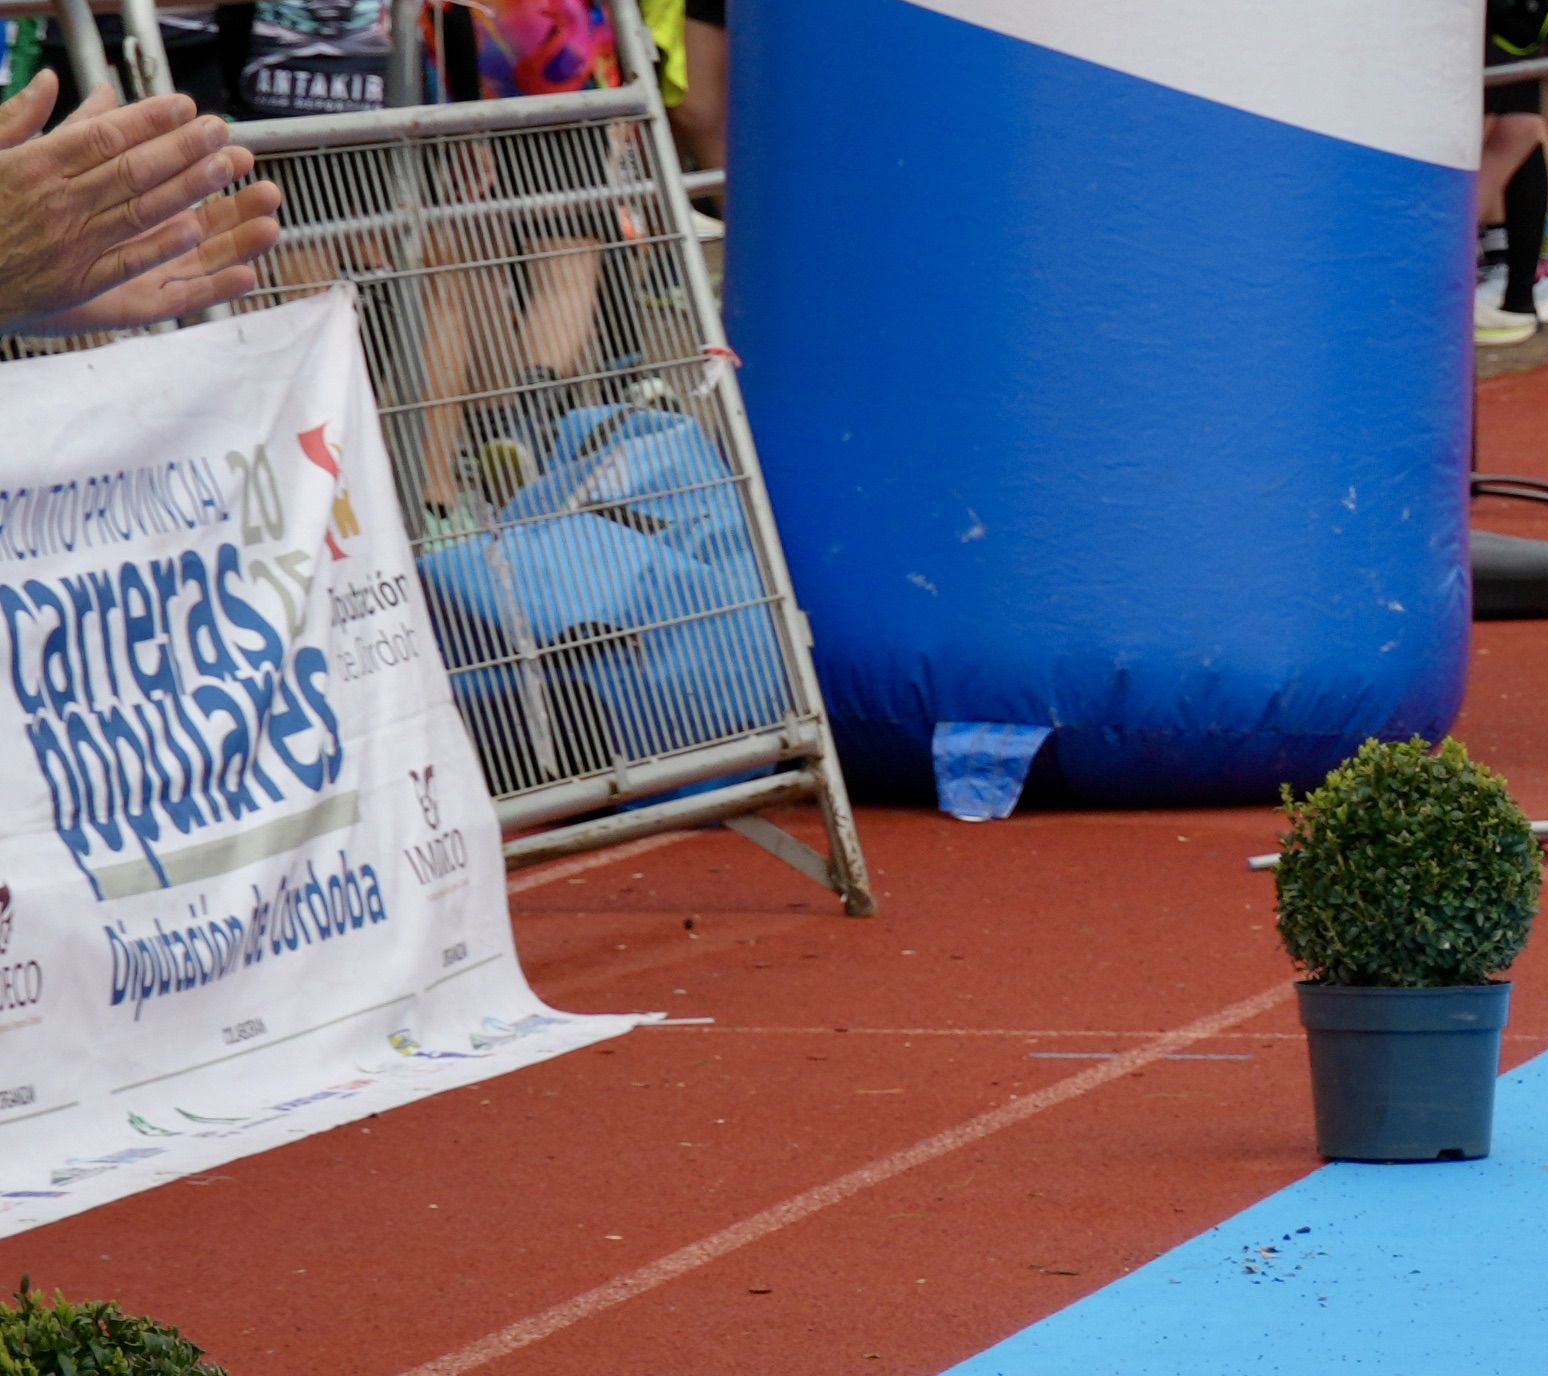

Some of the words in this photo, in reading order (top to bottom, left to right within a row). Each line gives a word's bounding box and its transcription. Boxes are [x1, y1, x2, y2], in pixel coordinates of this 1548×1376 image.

[225, 444, 285, 546] 20
[0, 543, 284, 716] carreras
[25, 646, 343, 902] populares
[104, 893, 244, 1023] Diputación
[270, 849, 387, 956] Córdoba
